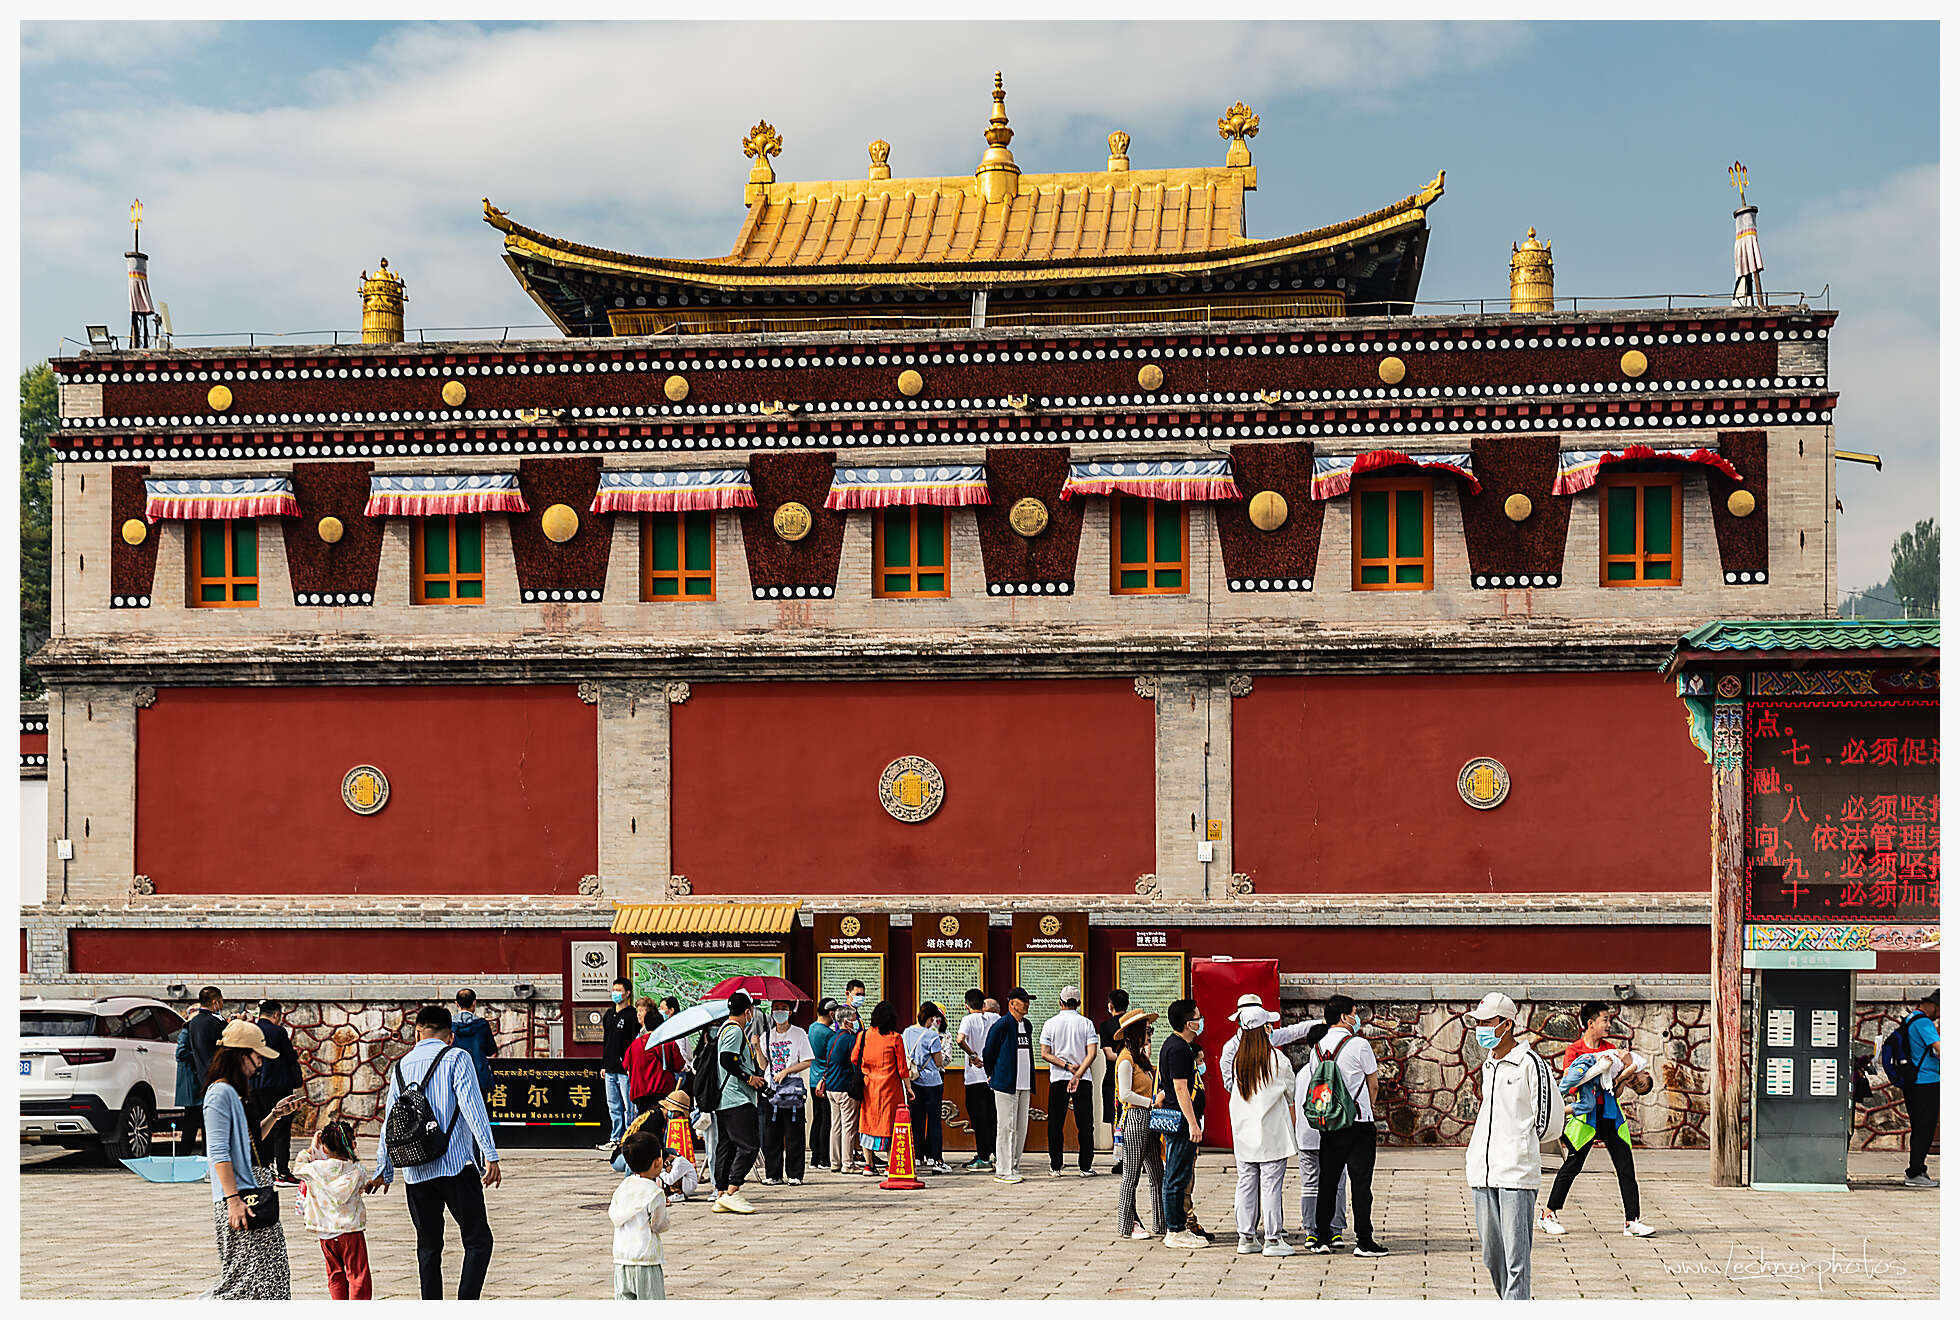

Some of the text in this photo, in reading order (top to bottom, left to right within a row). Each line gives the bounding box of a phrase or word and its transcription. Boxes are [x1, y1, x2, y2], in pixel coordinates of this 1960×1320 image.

[1755, 709, 1793, 737] 点。
[1753, 766, 1793, 794] 融。
[486, 1084, 592, 1108] 塔尔寺
[492, 1110, 583, 1120] Kumbum Monastery
